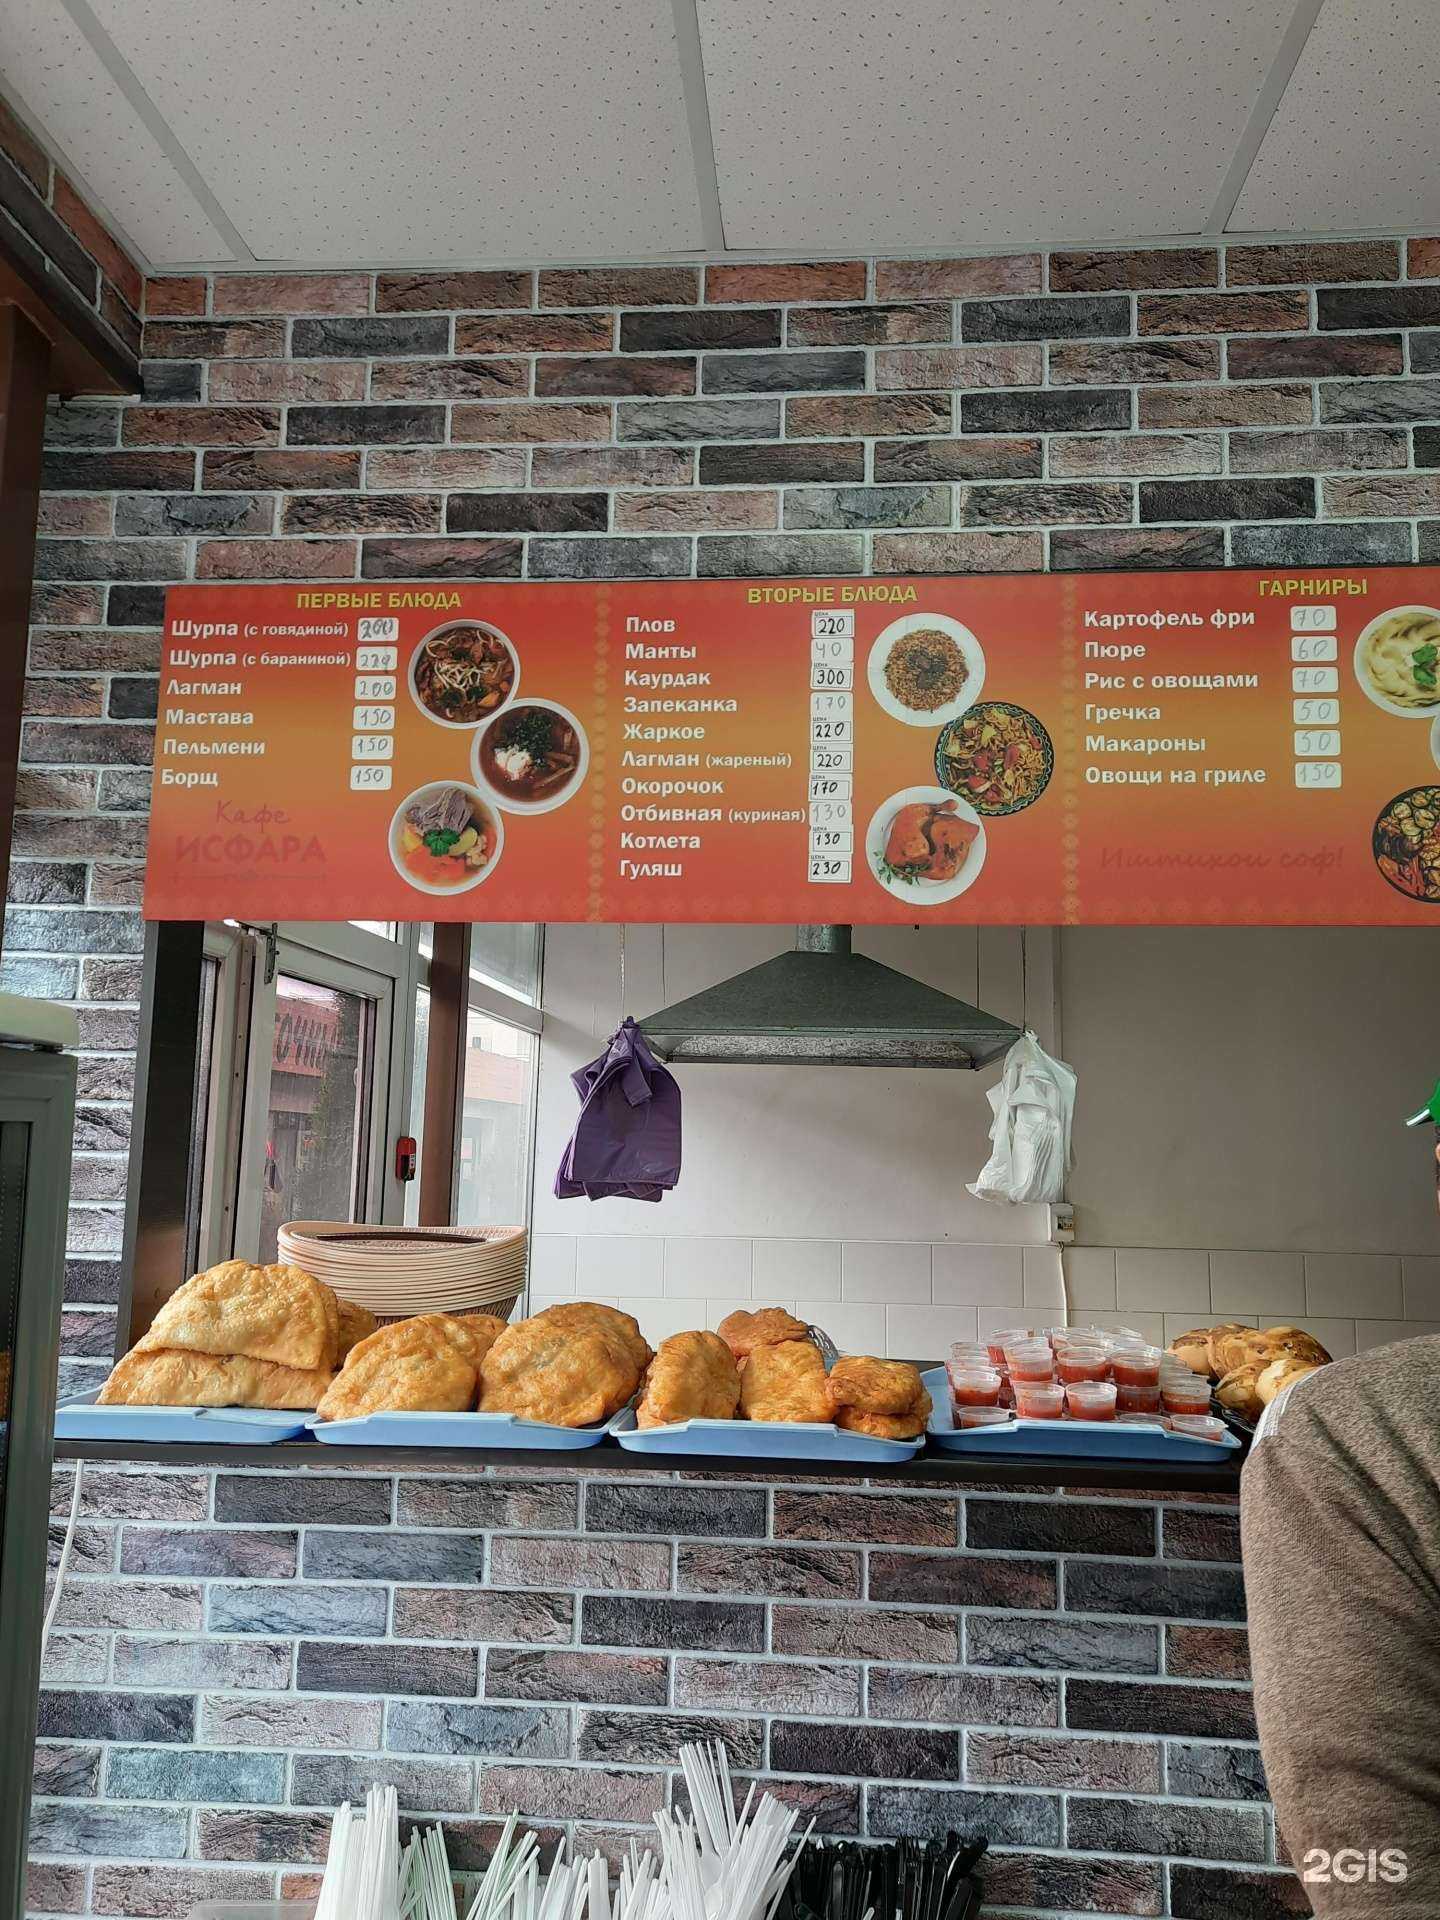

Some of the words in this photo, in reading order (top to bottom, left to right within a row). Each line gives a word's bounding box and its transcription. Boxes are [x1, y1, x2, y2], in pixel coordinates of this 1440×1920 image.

[747, 586, 835, 604] ВТОРЫЕ
[840, 585, 918, 604] БЛЮДА
[1259, 578, 1368, 596] ГАРНИРЫ
[296, 592, 382, 609] ПЕРВЫЕ
[388, 591, 463, 609] БЛЮДА
[625, 616, 676, 633] Плов
[818, 617, 845, 635] 220
[1084, 609, 1204, 631] Картофель
[1210, 608, 1256, 629] фри
[1294, 608, 1326, 627] 70
[171, 620, 238, 639] Шурпа
[243, 623, 258, 637] (с
[262, 623, 349, 638] говядиной)
[360, 619, 394, 640] 200
[625, 643, 697, 660] Манты
[815, 641, 842, 659] 40
[1084, 641, 1147, 662] Пюре
[1298, 638, 1329, 660] 60
[169, 649, 237, 669] Шурпа
[241, 653, 257, 668] (с
[259, 652, 351, 668] бараниной)
[624, 670, 711, 690] Каурдак
[817, 669, 845, 686] 300
[1085, 672, 1126, 689] Рис
[1132, 676, 1145, 689] с
[1151, 674, 1259, 691] овощами
[1297, 670, 1326, 689] 70
[166, 679, 242, 696] Лагман
[623, 696, 738, 713] Запеканка
[816, 695, 846, 711] 170
[1299, 700, 1332, 722] 50
[165, 708, 254, 725] Мастава
[361, 708, 391, 726] 150
[1085, 703, 1161, 724] Гречка
[623, 723, 706, 742] Жаркое
[815, 721, 845, 739] 220
[163, 738, 266, 756] Пельмени
[358, 737, 389, 754] 150
[1085, 734, 1207, 755] Макароны
[1299, 730, 1332, 753] 50
[621, 750, 701, 767] Лагман
[705, 752, 793, 768] (жареный)
[817, 753, 843, 768] 220
[161, 767, 219, 789] Борщ
[355, 767, 384, 784] 150
[1085, 766, 1163, 786] Овощи
[1169, 770, 1198, 784] на
[1203, 769, 1267, 787] гриле
[1300, 763, 1336, 783] 150
[621, 777, 724, 797] Окорочок
[812, 780, 839, 796] 170
[215, 799, 292, 834] Кафе
[620, 803, 723, 822] Отбивная
[728, 807, 806, 824] (куриная)
[813, 803, 846, 823] 130
[620, 832, 702, 849] Котлета
[815, 832, 841, 847] 130
[174, 834, 328, 865] ИСФАРА
[620, 859, 683, 880] Гуляш
[812, 860, 842, 876] 230
